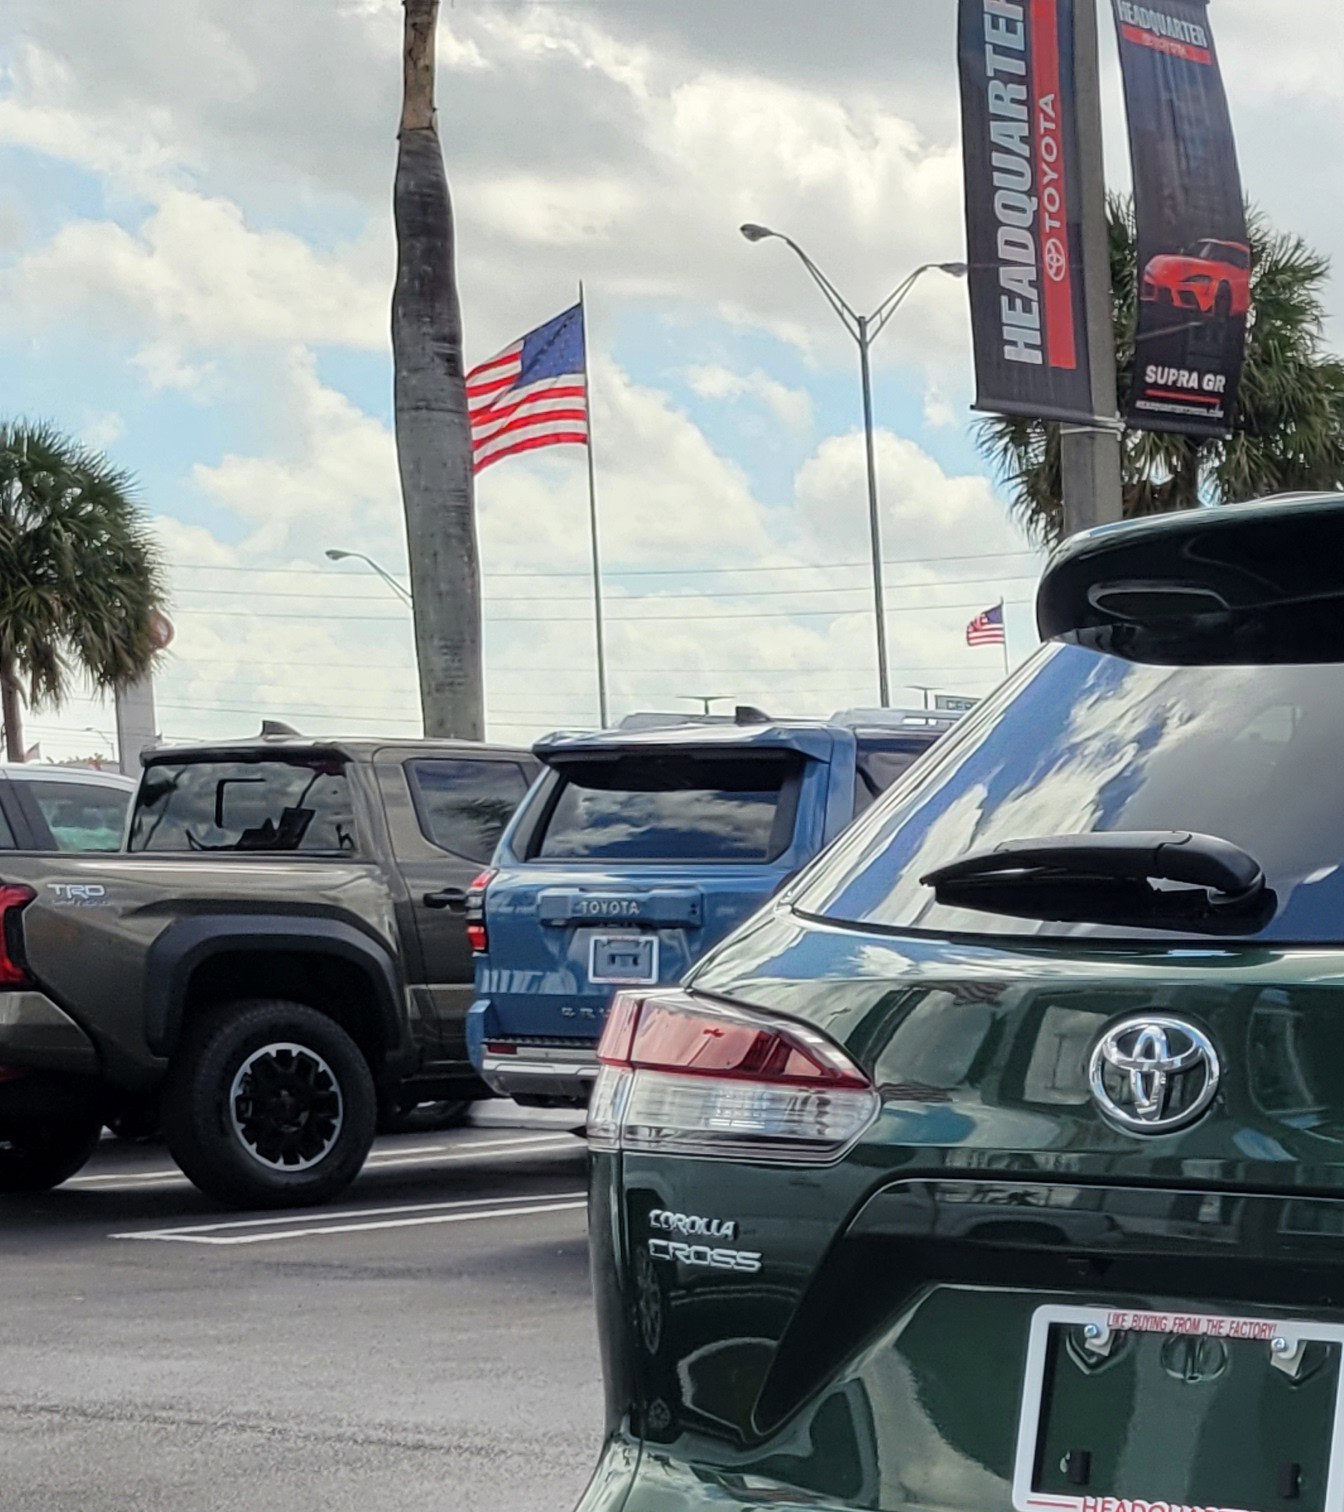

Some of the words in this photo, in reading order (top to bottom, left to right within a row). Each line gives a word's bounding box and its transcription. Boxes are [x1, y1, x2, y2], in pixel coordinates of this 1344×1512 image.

[1039, 93, 1061, 234] TOYOTA
[1145, 365, 1199, 390] SUPRA
[1202, 374, 1226, 393] GR
[47, 883, 105, 899] TRD
[581, 901, 640, 915] TOYOTA
[649, 1209, 736, 1240] COROLLA
[648, 1238, 762, 1271] CROSS
[1107, 1313, 1128, 1327] LIKE
[1132, 1314, 1168, 1331] BUYING
[1173, 1316, 1200, 1333] FROM
[1206, 1319, 1225, 1334] THE
